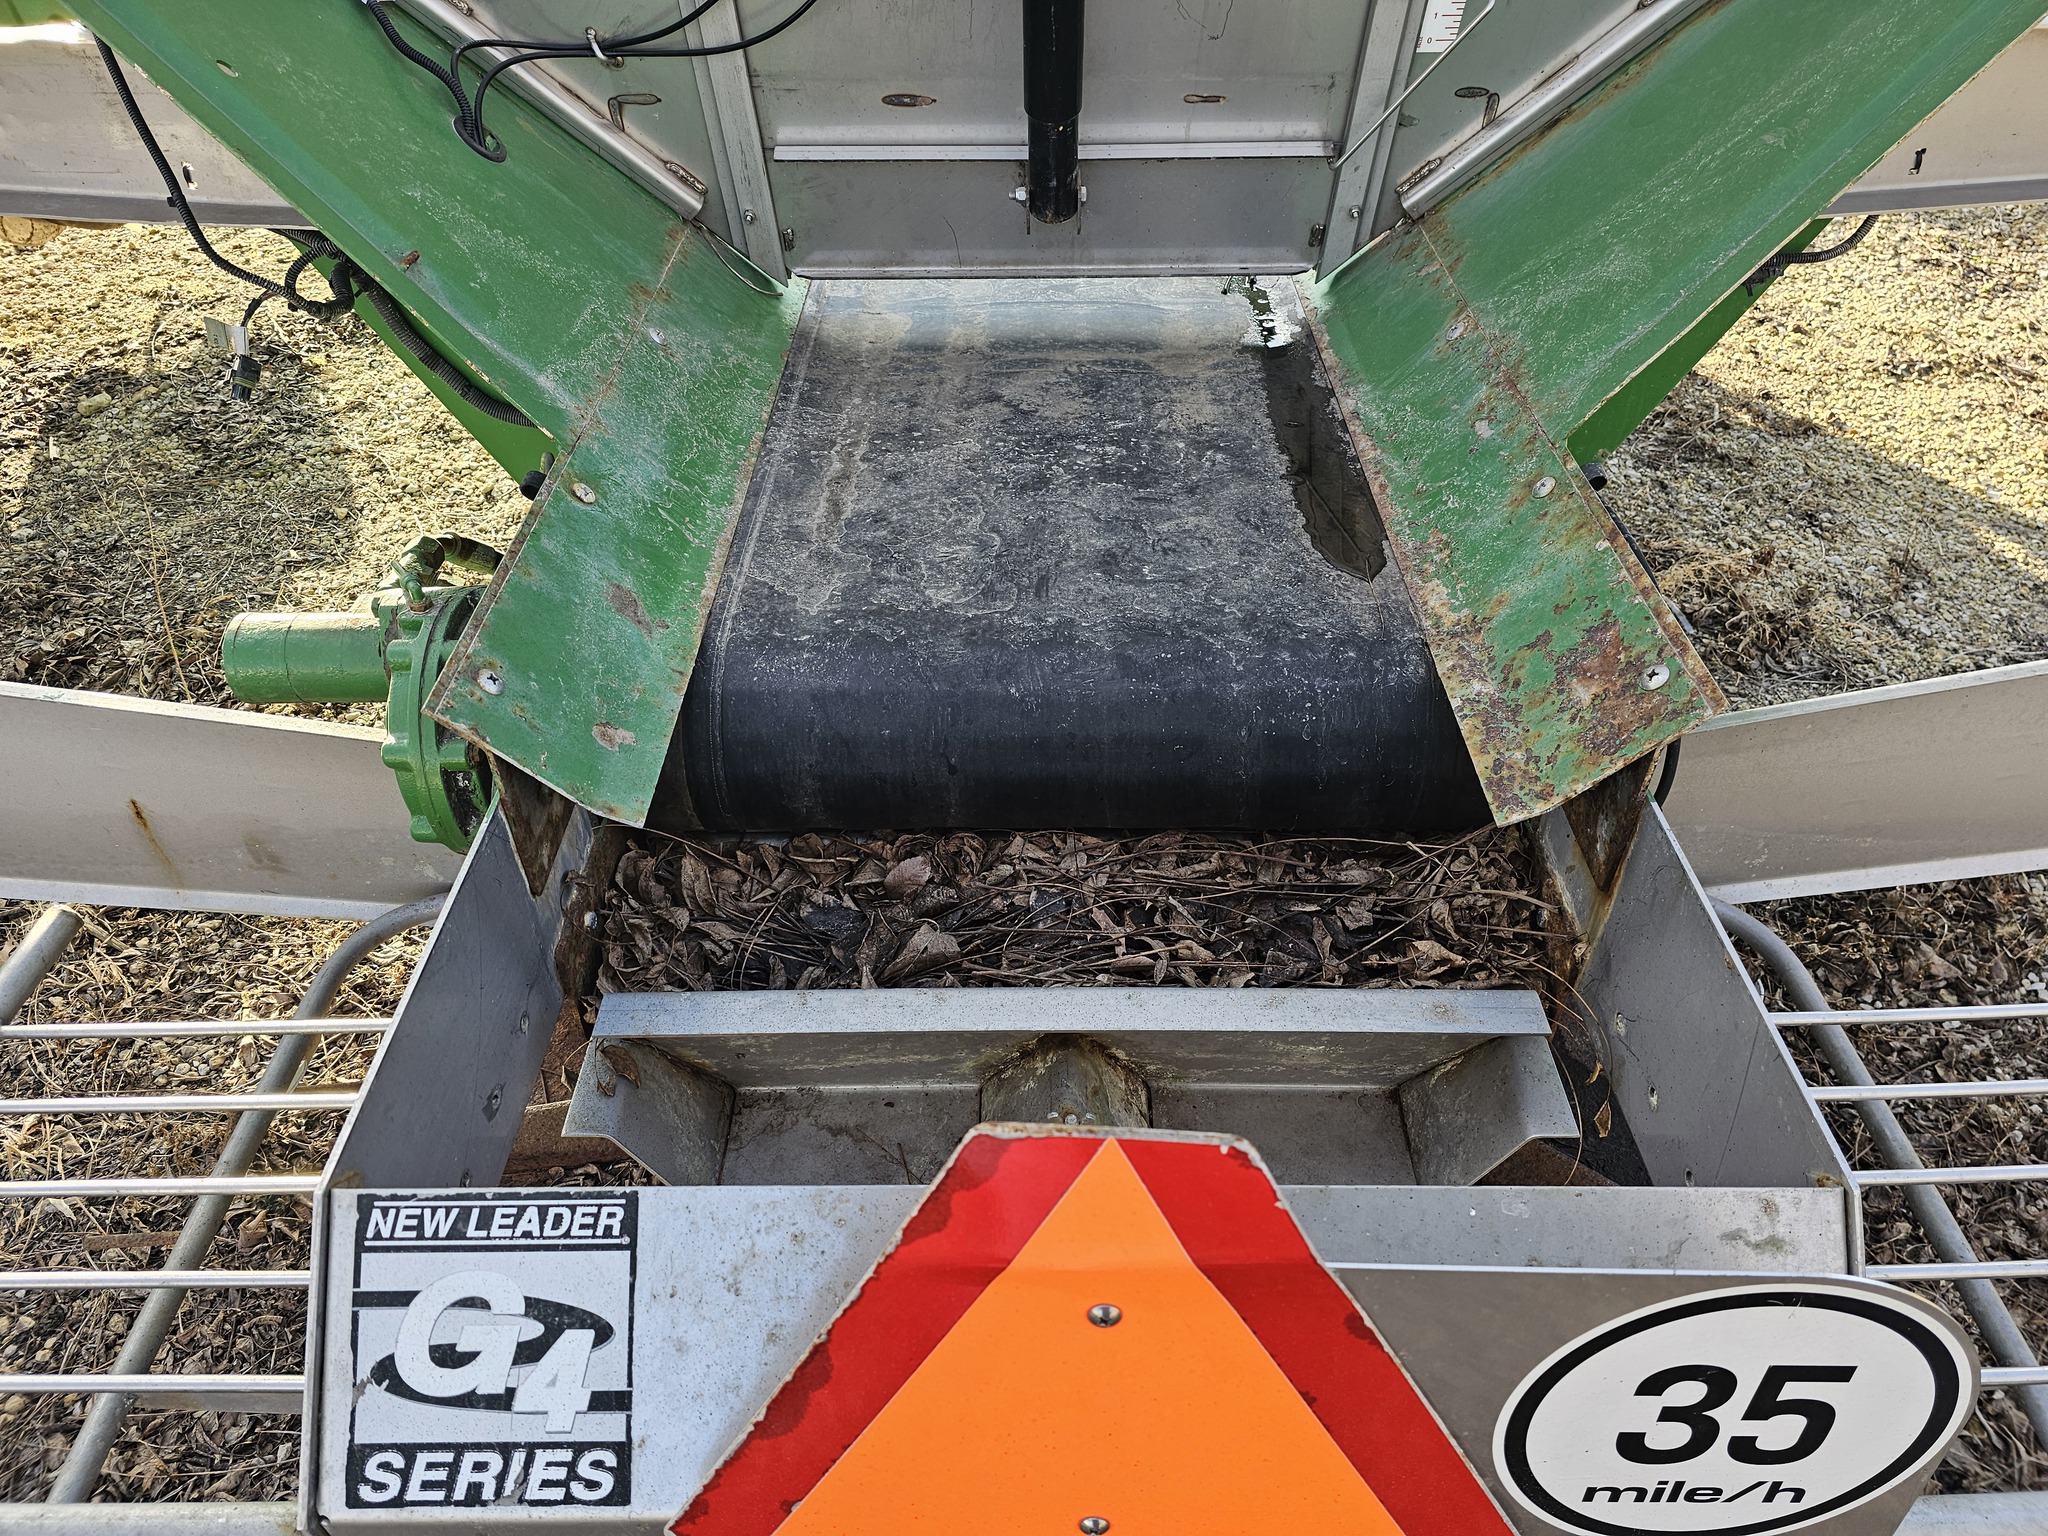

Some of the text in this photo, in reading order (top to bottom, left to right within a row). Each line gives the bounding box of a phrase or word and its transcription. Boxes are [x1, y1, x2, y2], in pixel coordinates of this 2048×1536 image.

[366, 1206, 625, 1239] NEW LEADER
[394, 1269, 596, 1434] G4
[1615, 1364, 1858, 1466] 35
[357, 1448, 618, 1502] SERIES
[1581, 1480, 1807, 1504] mile/h
